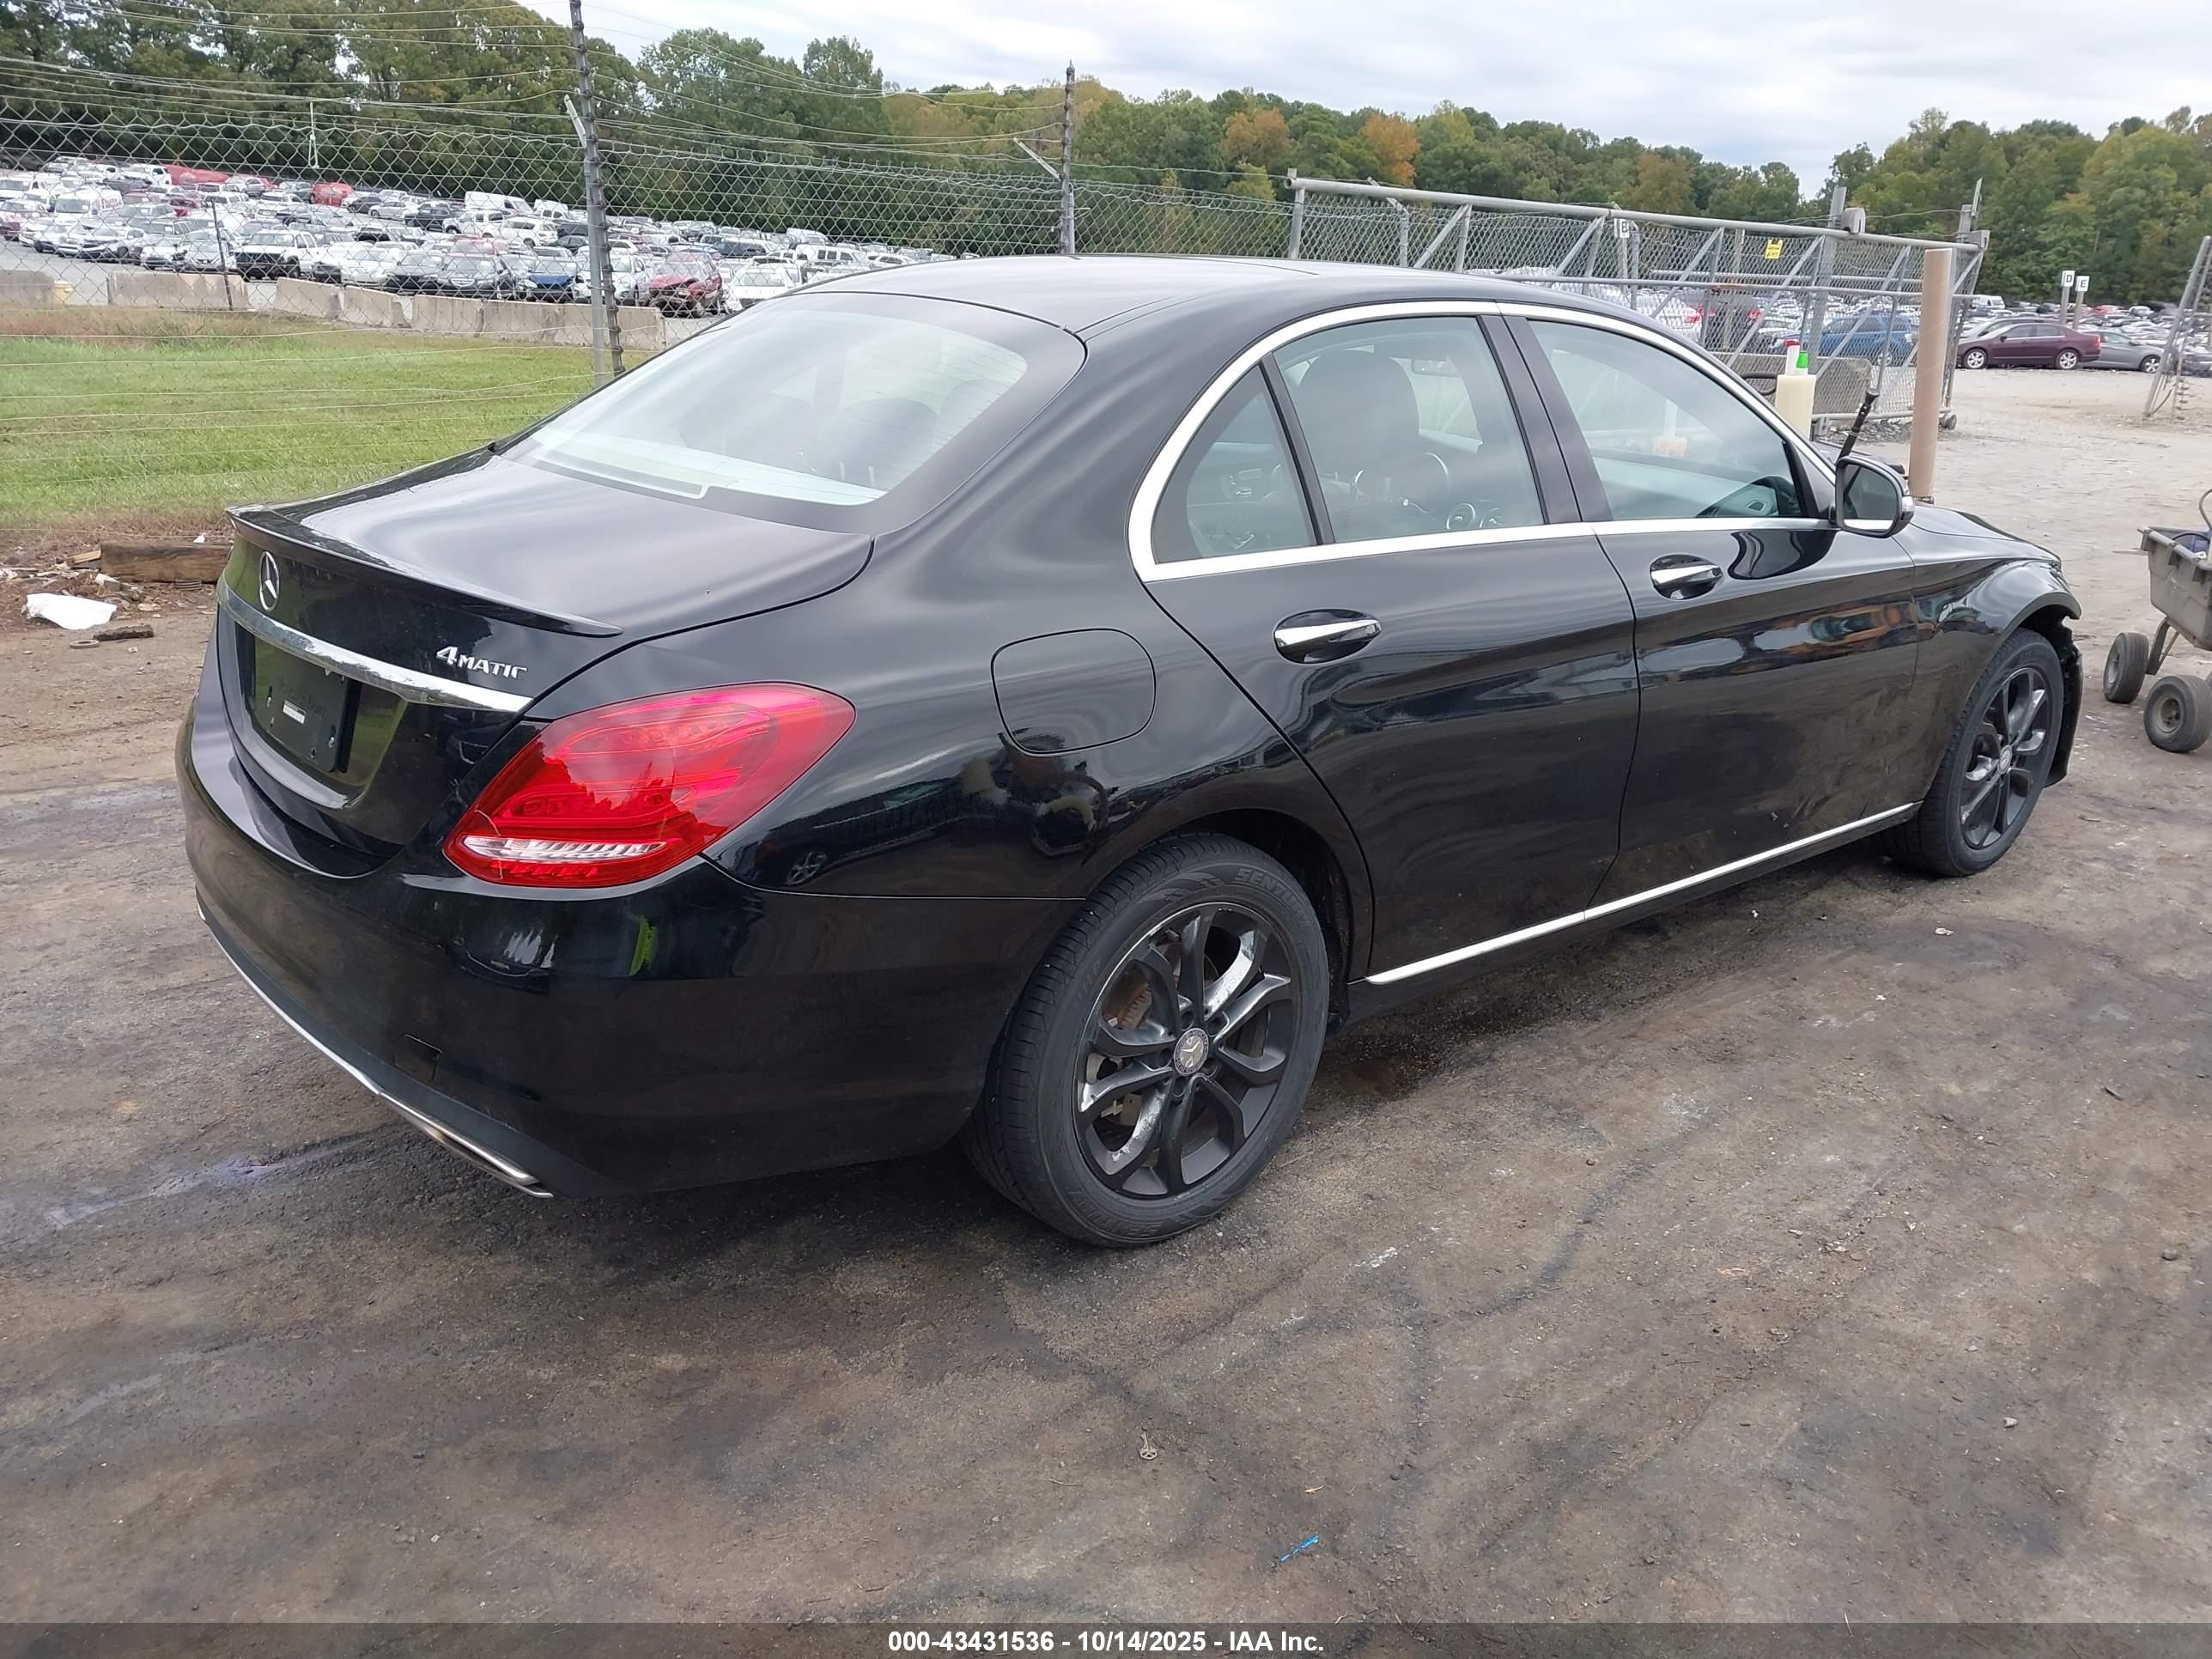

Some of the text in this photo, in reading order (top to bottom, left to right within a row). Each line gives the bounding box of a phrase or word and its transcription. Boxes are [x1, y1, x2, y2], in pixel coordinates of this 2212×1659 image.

[2066, 274, 2073, 283] D
[2080, 279, 2087, 288] E
[436, 645, 527, 679] 4MATIC
